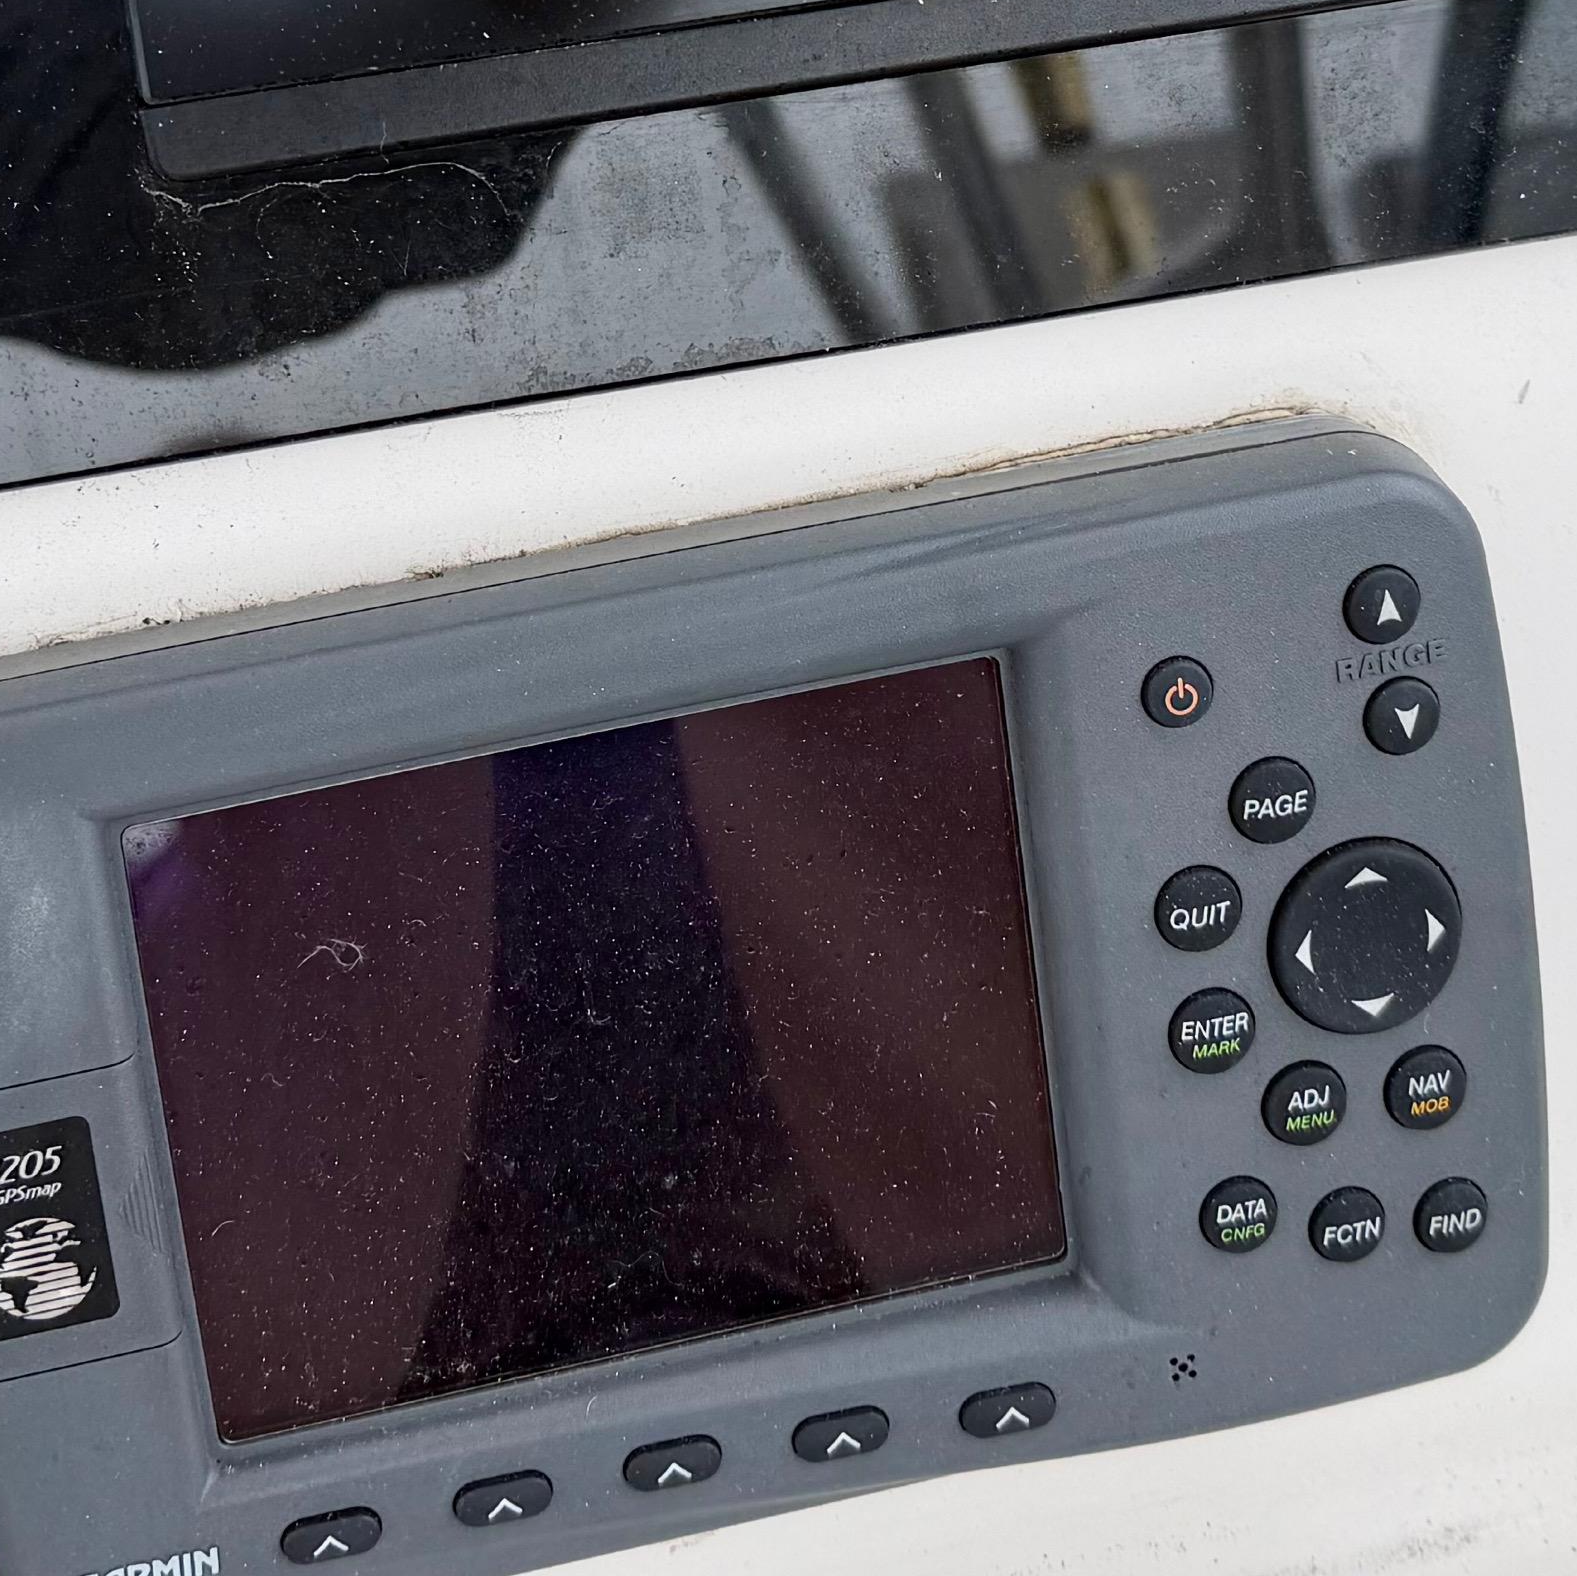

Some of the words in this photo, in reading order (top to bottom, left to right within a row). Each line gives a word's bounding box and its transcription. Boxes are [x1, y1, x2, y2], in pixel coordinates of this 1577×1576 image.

[1335, 639, 1448, 684] RANGE
[1242, 789, 1310, 821] PAGE
[1169, 900, 1232, 931] QUIT
[1180, 1012, 1250, 1042] ENTER
[1192, 1038, 1241, 1060] MARK
[1408, 1070, 1450, 1097] NAV
[1287, 1085, 1331, 1113] ADJ
[1410, 1095, 1450, 1117] MOB
[1285, 1109, 1335, 1132] MENU
[1216, 1198, 1268, 1225] DATA
[1429, 1207, 1481, 1237] FIND
[1220, 1222, 1265, 1244] CNFG
[1323, 1218, 1382, 1247] FCTN
[79, 1546, 220, 1576] MIN
